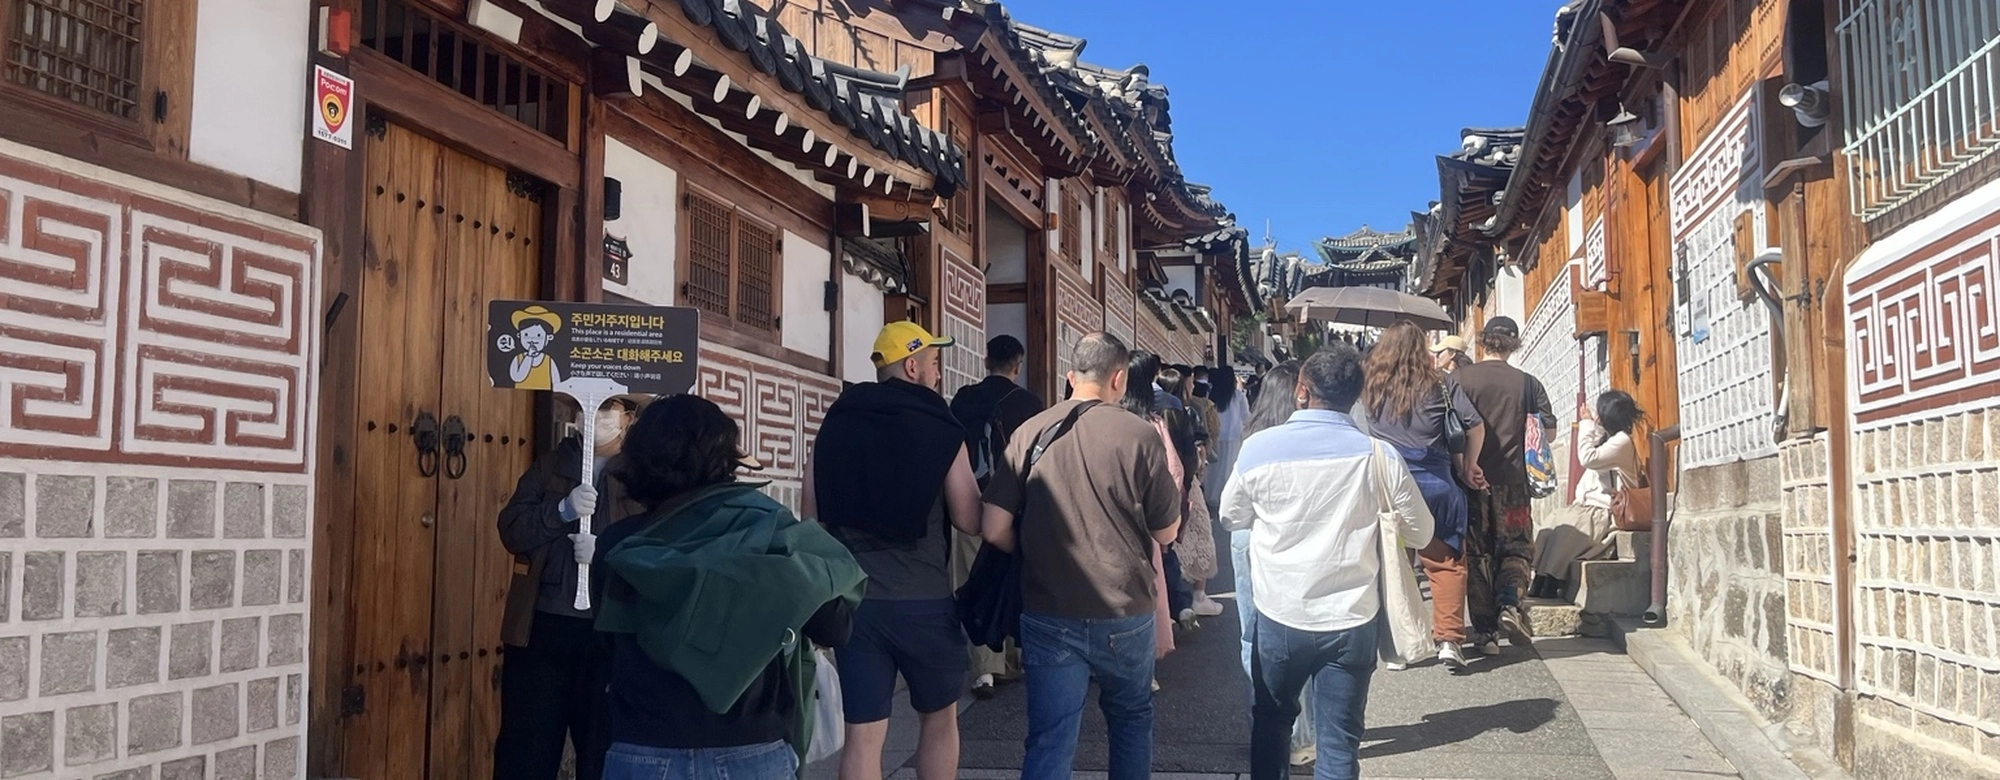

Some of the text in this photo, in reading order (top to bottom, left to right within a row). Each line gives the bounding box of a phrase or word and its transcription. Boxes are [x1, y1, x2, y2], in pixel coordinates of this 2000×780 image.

[610, 262, 620, 279] 43
[571, 313, 664, 329] 주민거주지입니다
[585, 328, 602, 336] place
[500, 337, 511, 350] 쉿
[570, 347, 683, 363] 소곤소곤 대화해주세요
[570, 362, 587, 370] Keep
